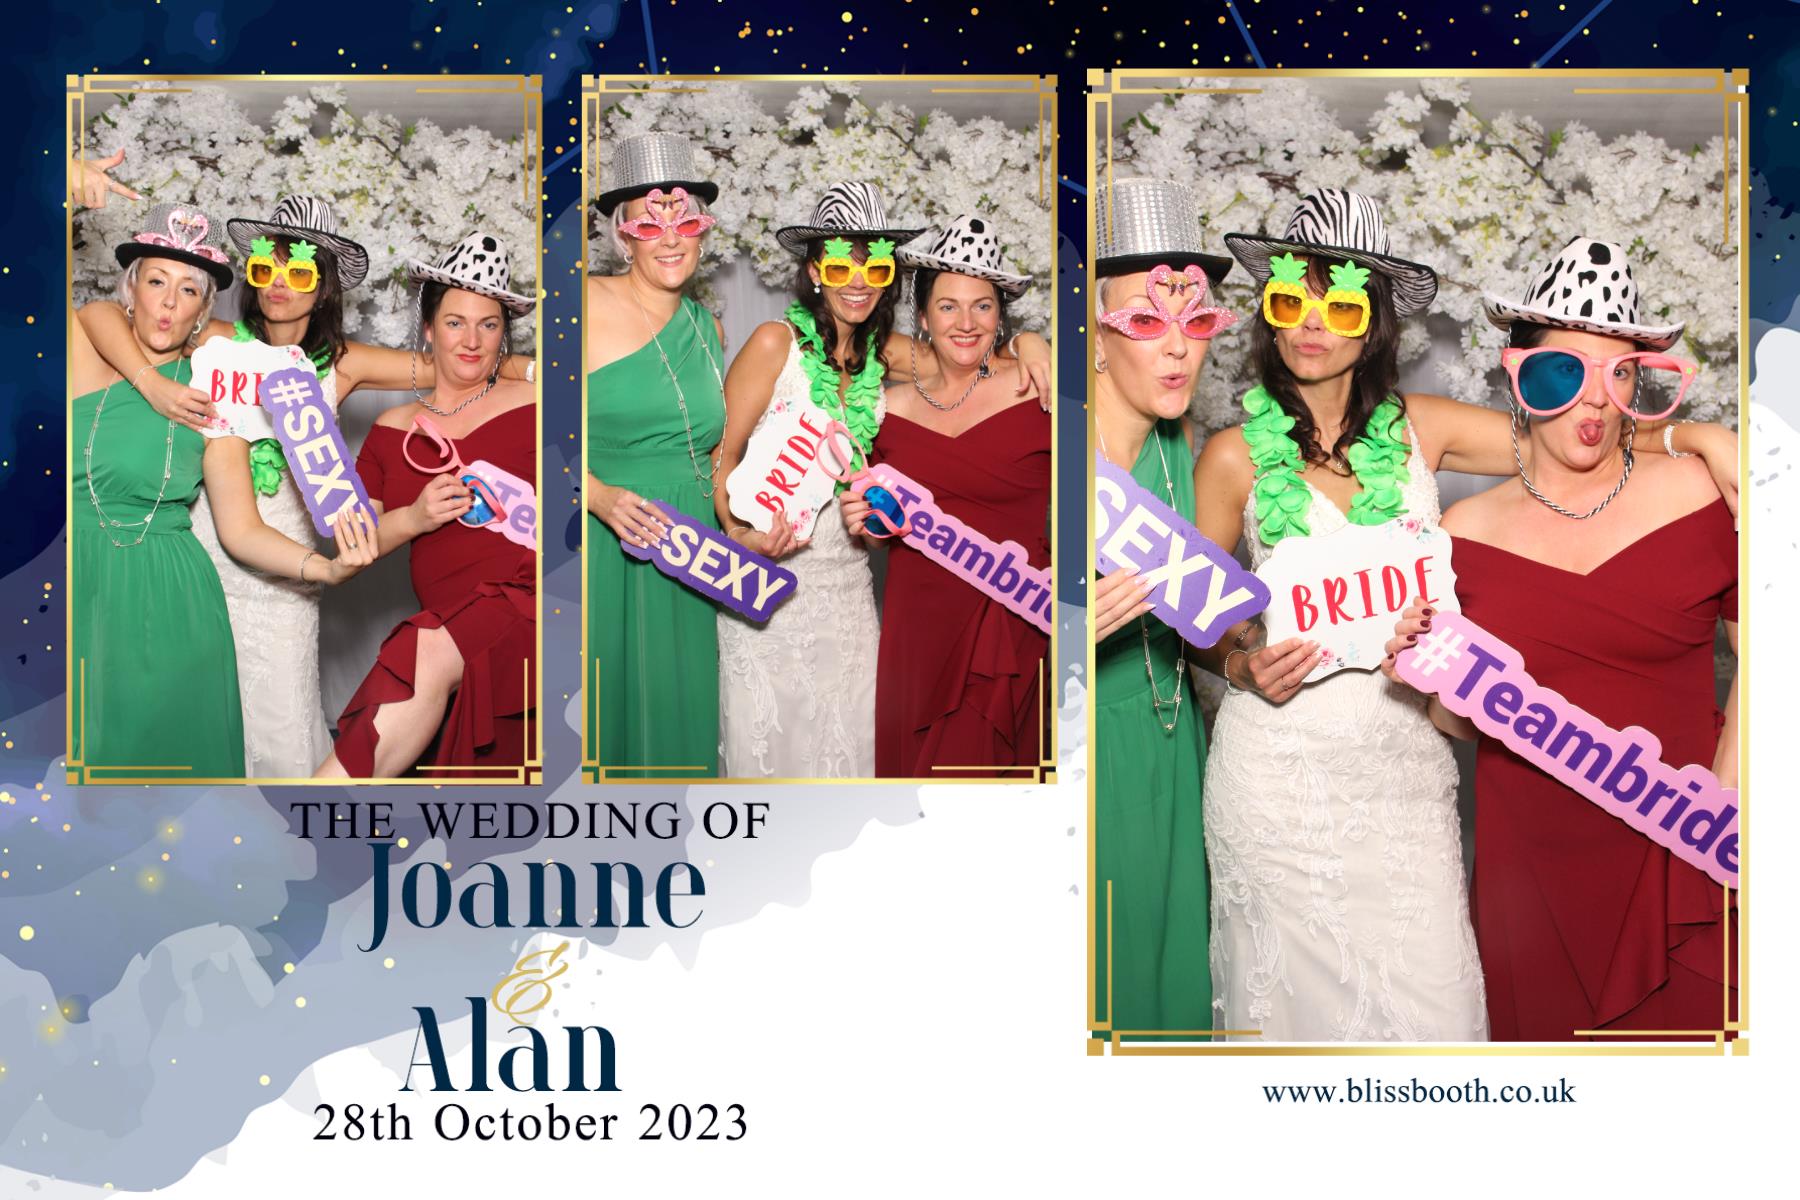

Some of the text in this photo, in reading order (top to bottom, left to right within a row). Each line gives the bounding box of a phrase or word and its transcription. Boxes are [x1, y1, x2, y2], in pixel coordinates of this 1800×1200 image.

[269, 377, 366, 527] #SEXY
[755, 411, 828, 513] BRIDE
[636, 516, 788, 611] SEXY
[1291, 556, 1439, 632] BRIDE
